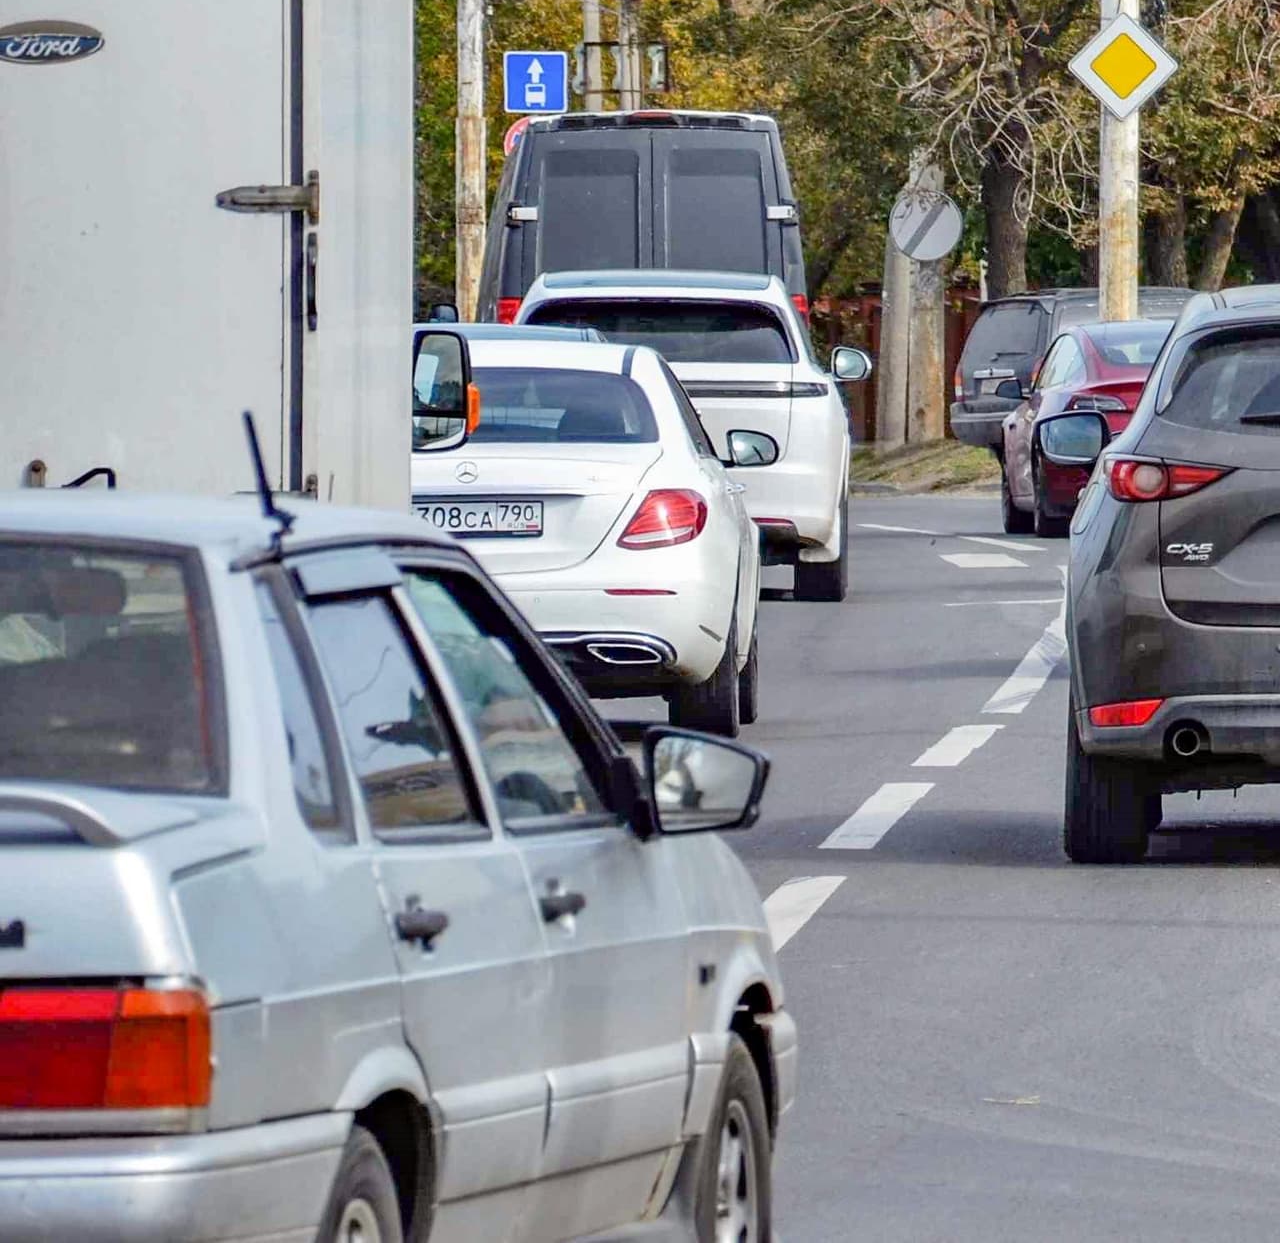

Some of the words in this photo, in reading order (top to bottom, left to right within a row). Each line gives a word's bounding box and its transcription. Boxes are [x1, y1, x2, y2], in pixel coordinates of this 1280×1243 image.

[6, 35, 81, 57] Ford
[499, 505, 535, 522] 790
[1166, 543, 1214, 554] CX-5
